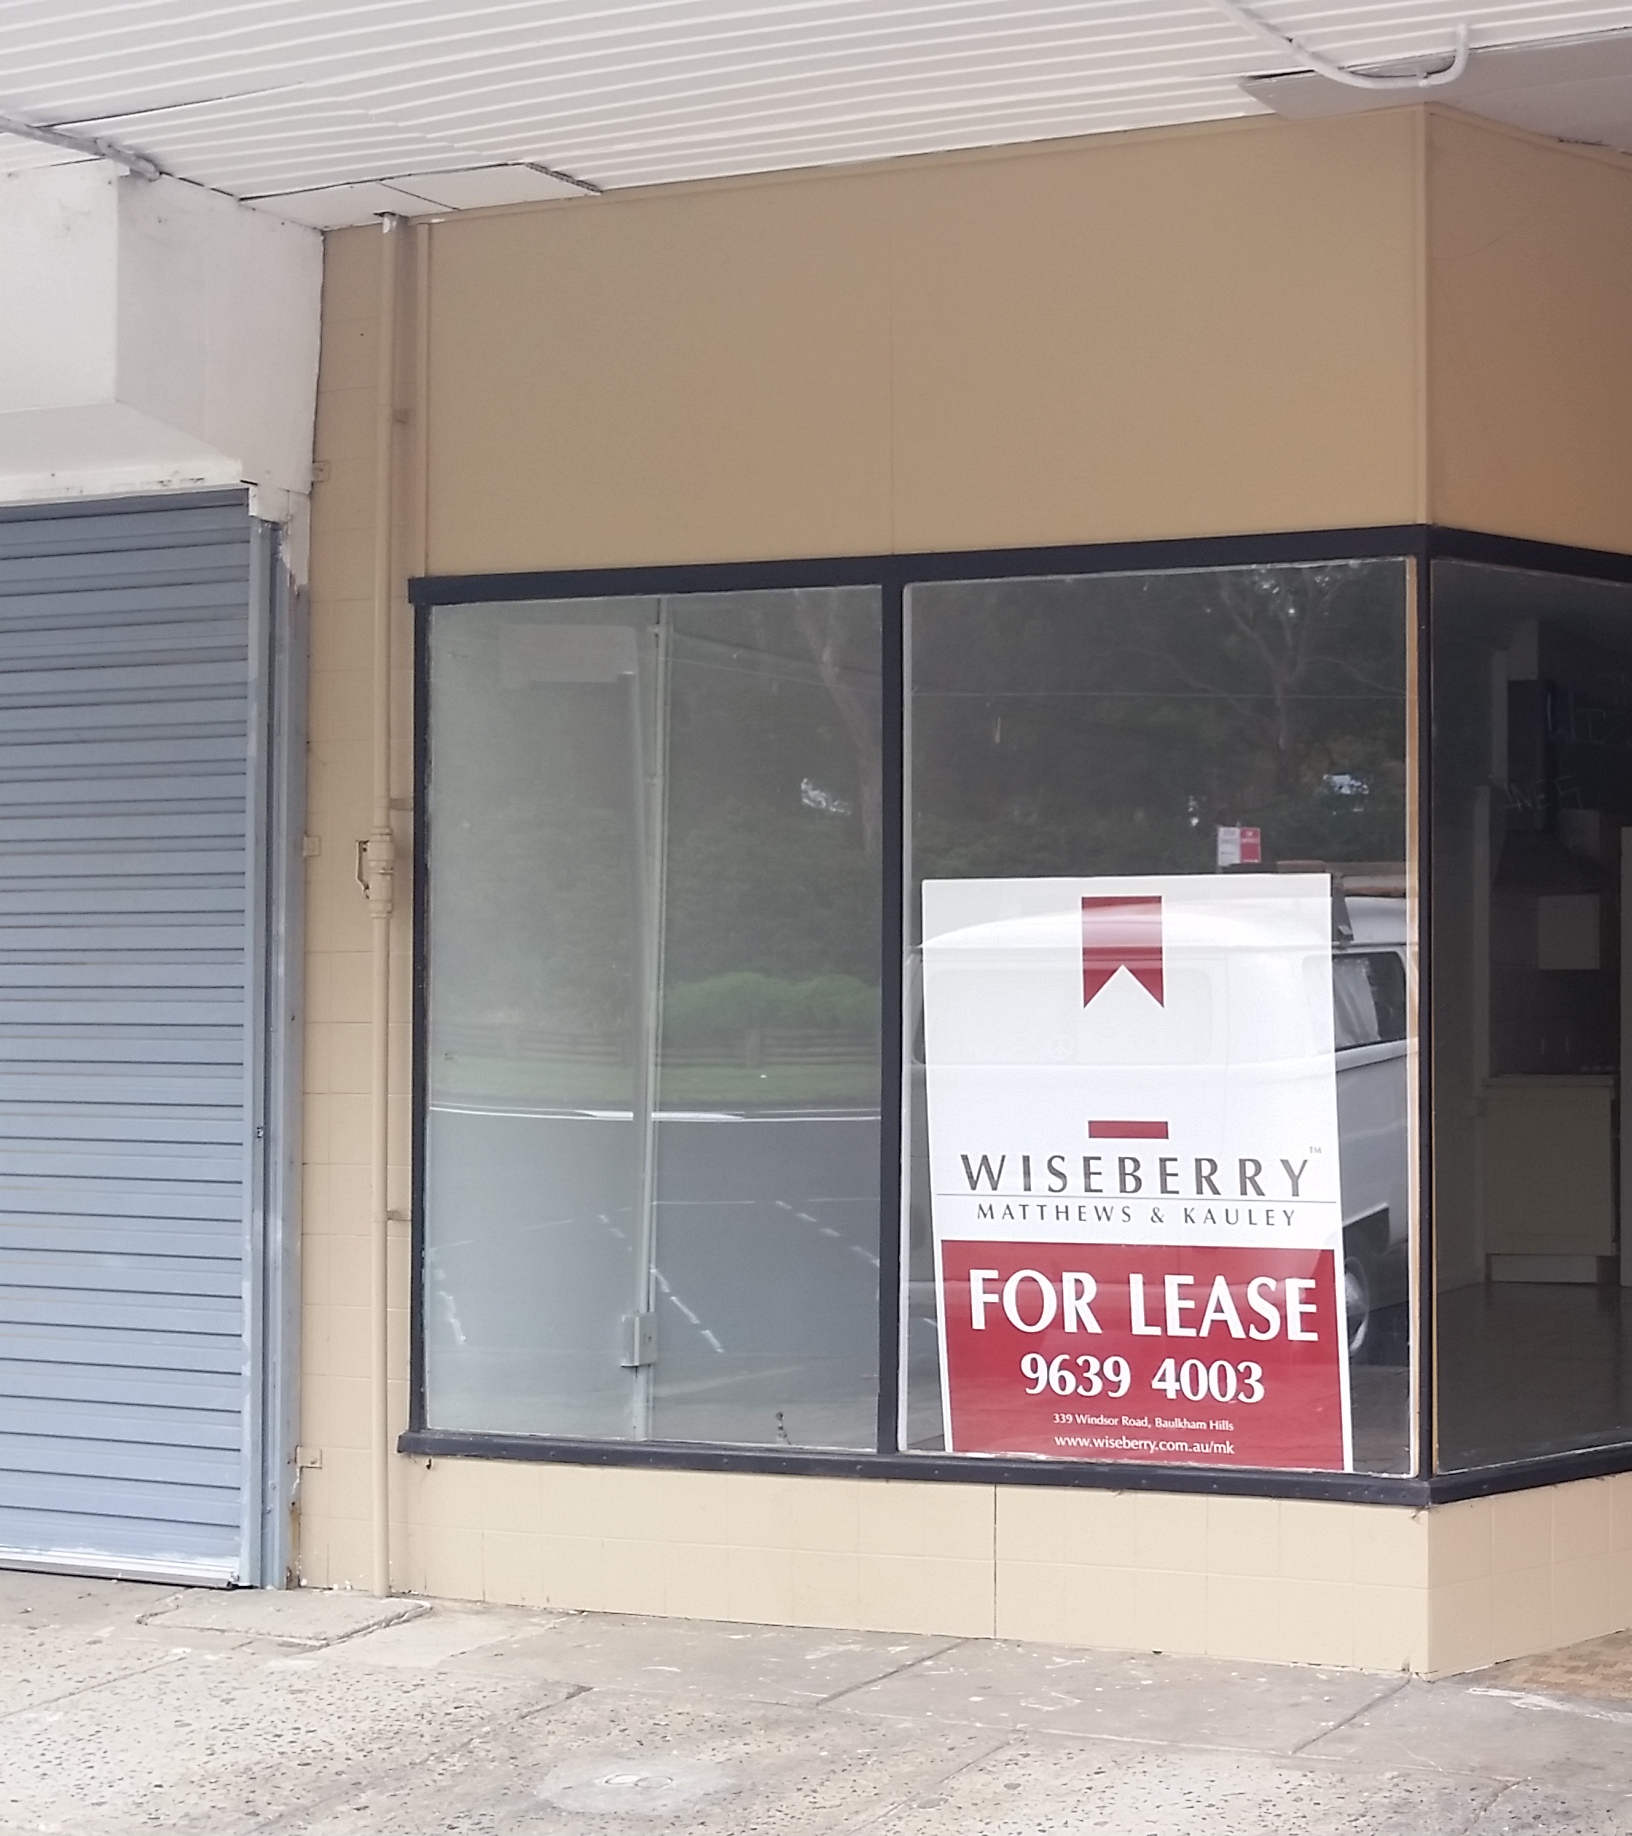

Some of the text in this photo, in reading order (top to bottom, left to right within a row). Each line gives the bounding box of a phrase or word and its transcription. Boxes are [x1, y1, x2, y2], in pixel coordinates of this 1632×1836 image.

[960, 1154, 1308, 1197] WISEBERRY
[977, 1203, 1294, 1226] MATTHEWS & KAULEY
[968, 1267, 1318, 1342] FOR LEASE
[1019, 1352, 1265, 1403] 9639 4003
[1053, 1413, 1234, 1431] 339 Windsor Road, Baulkham Hills
[1054, 1435, 1235, 1455] www.wiseberry.com.au/mk
